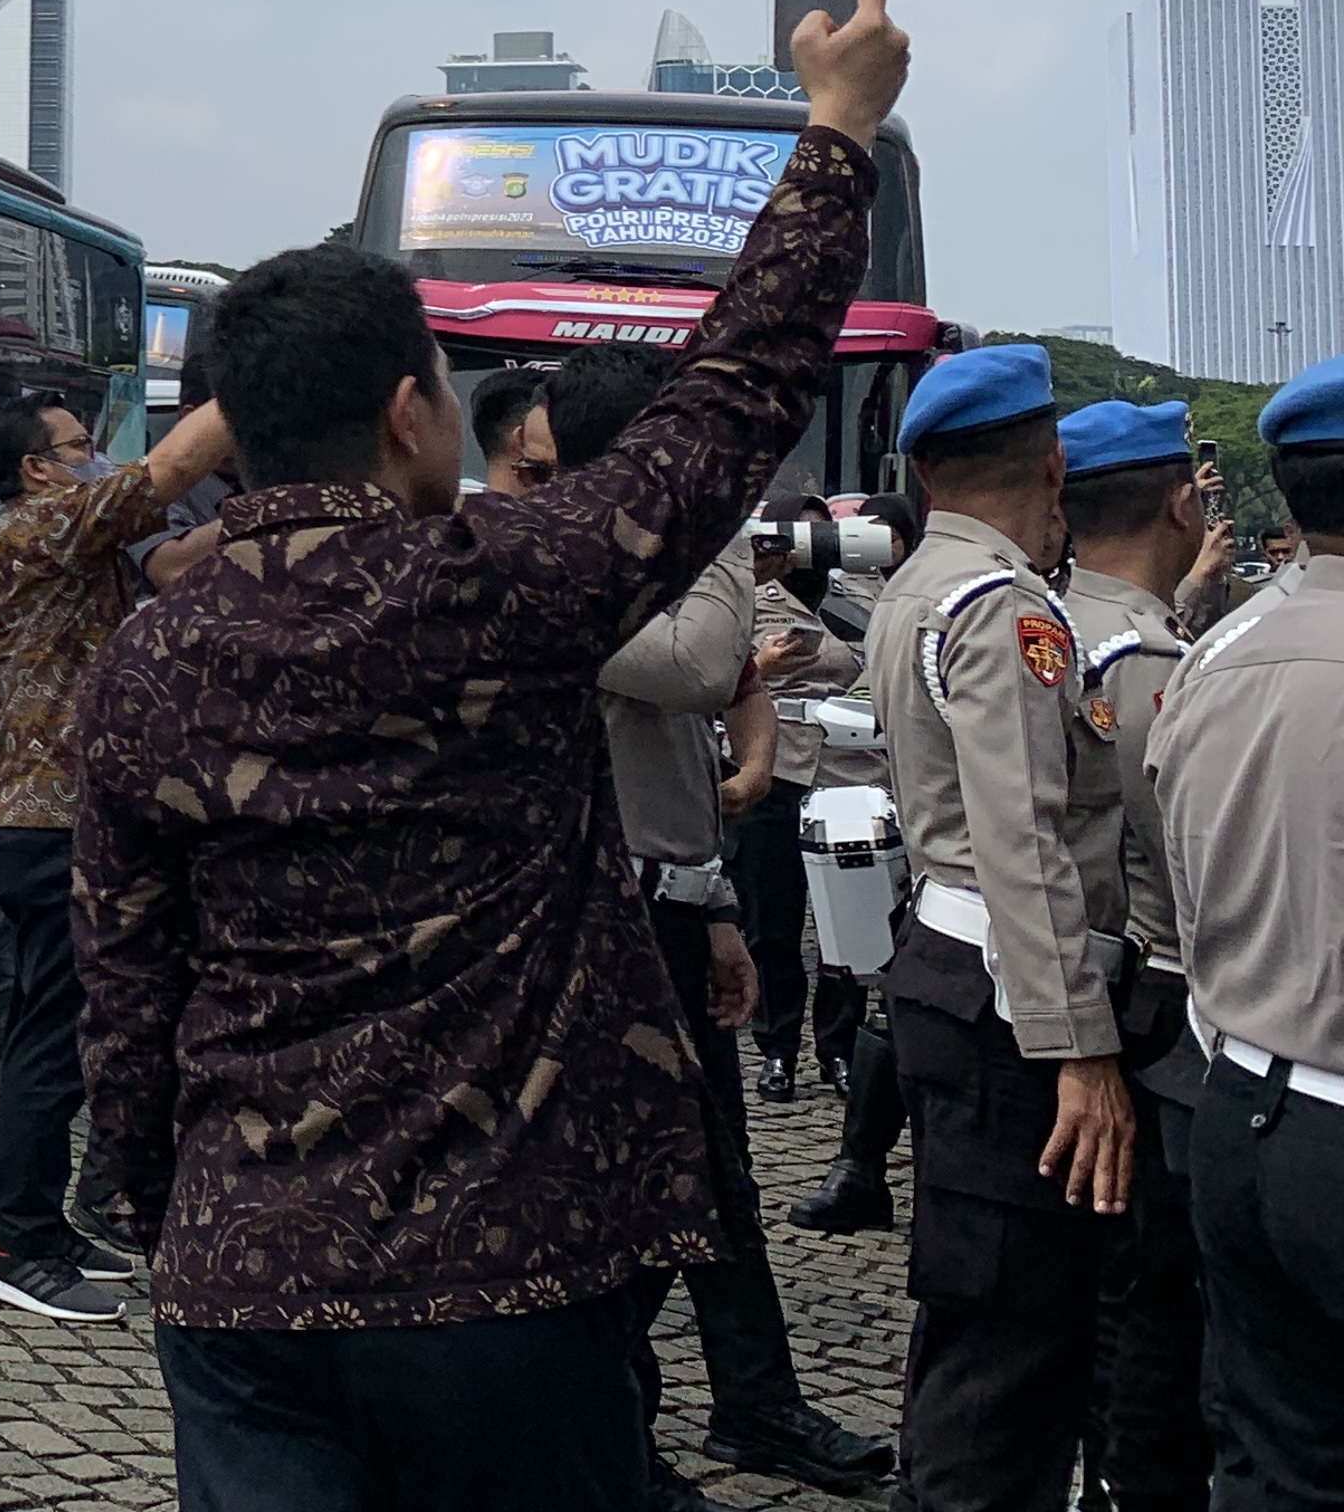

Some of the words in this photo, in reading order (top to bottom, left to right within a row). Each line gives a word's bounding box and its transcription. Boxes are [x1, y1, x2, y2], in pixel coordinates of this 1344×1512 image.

[558, 133, 778, 179] MUDIK
[551, 168, 776, 214] GRATIS
[569, 209, 654, 233] POLRI
[655, 209, 750, 236] PRESIS
[584, 226, 676, 244] TAHUN
[677, 227, 743, 250] 2023
[551, 321, 691, 345] MAUDI
[1022, 619, 1067, 640] PROPAM
